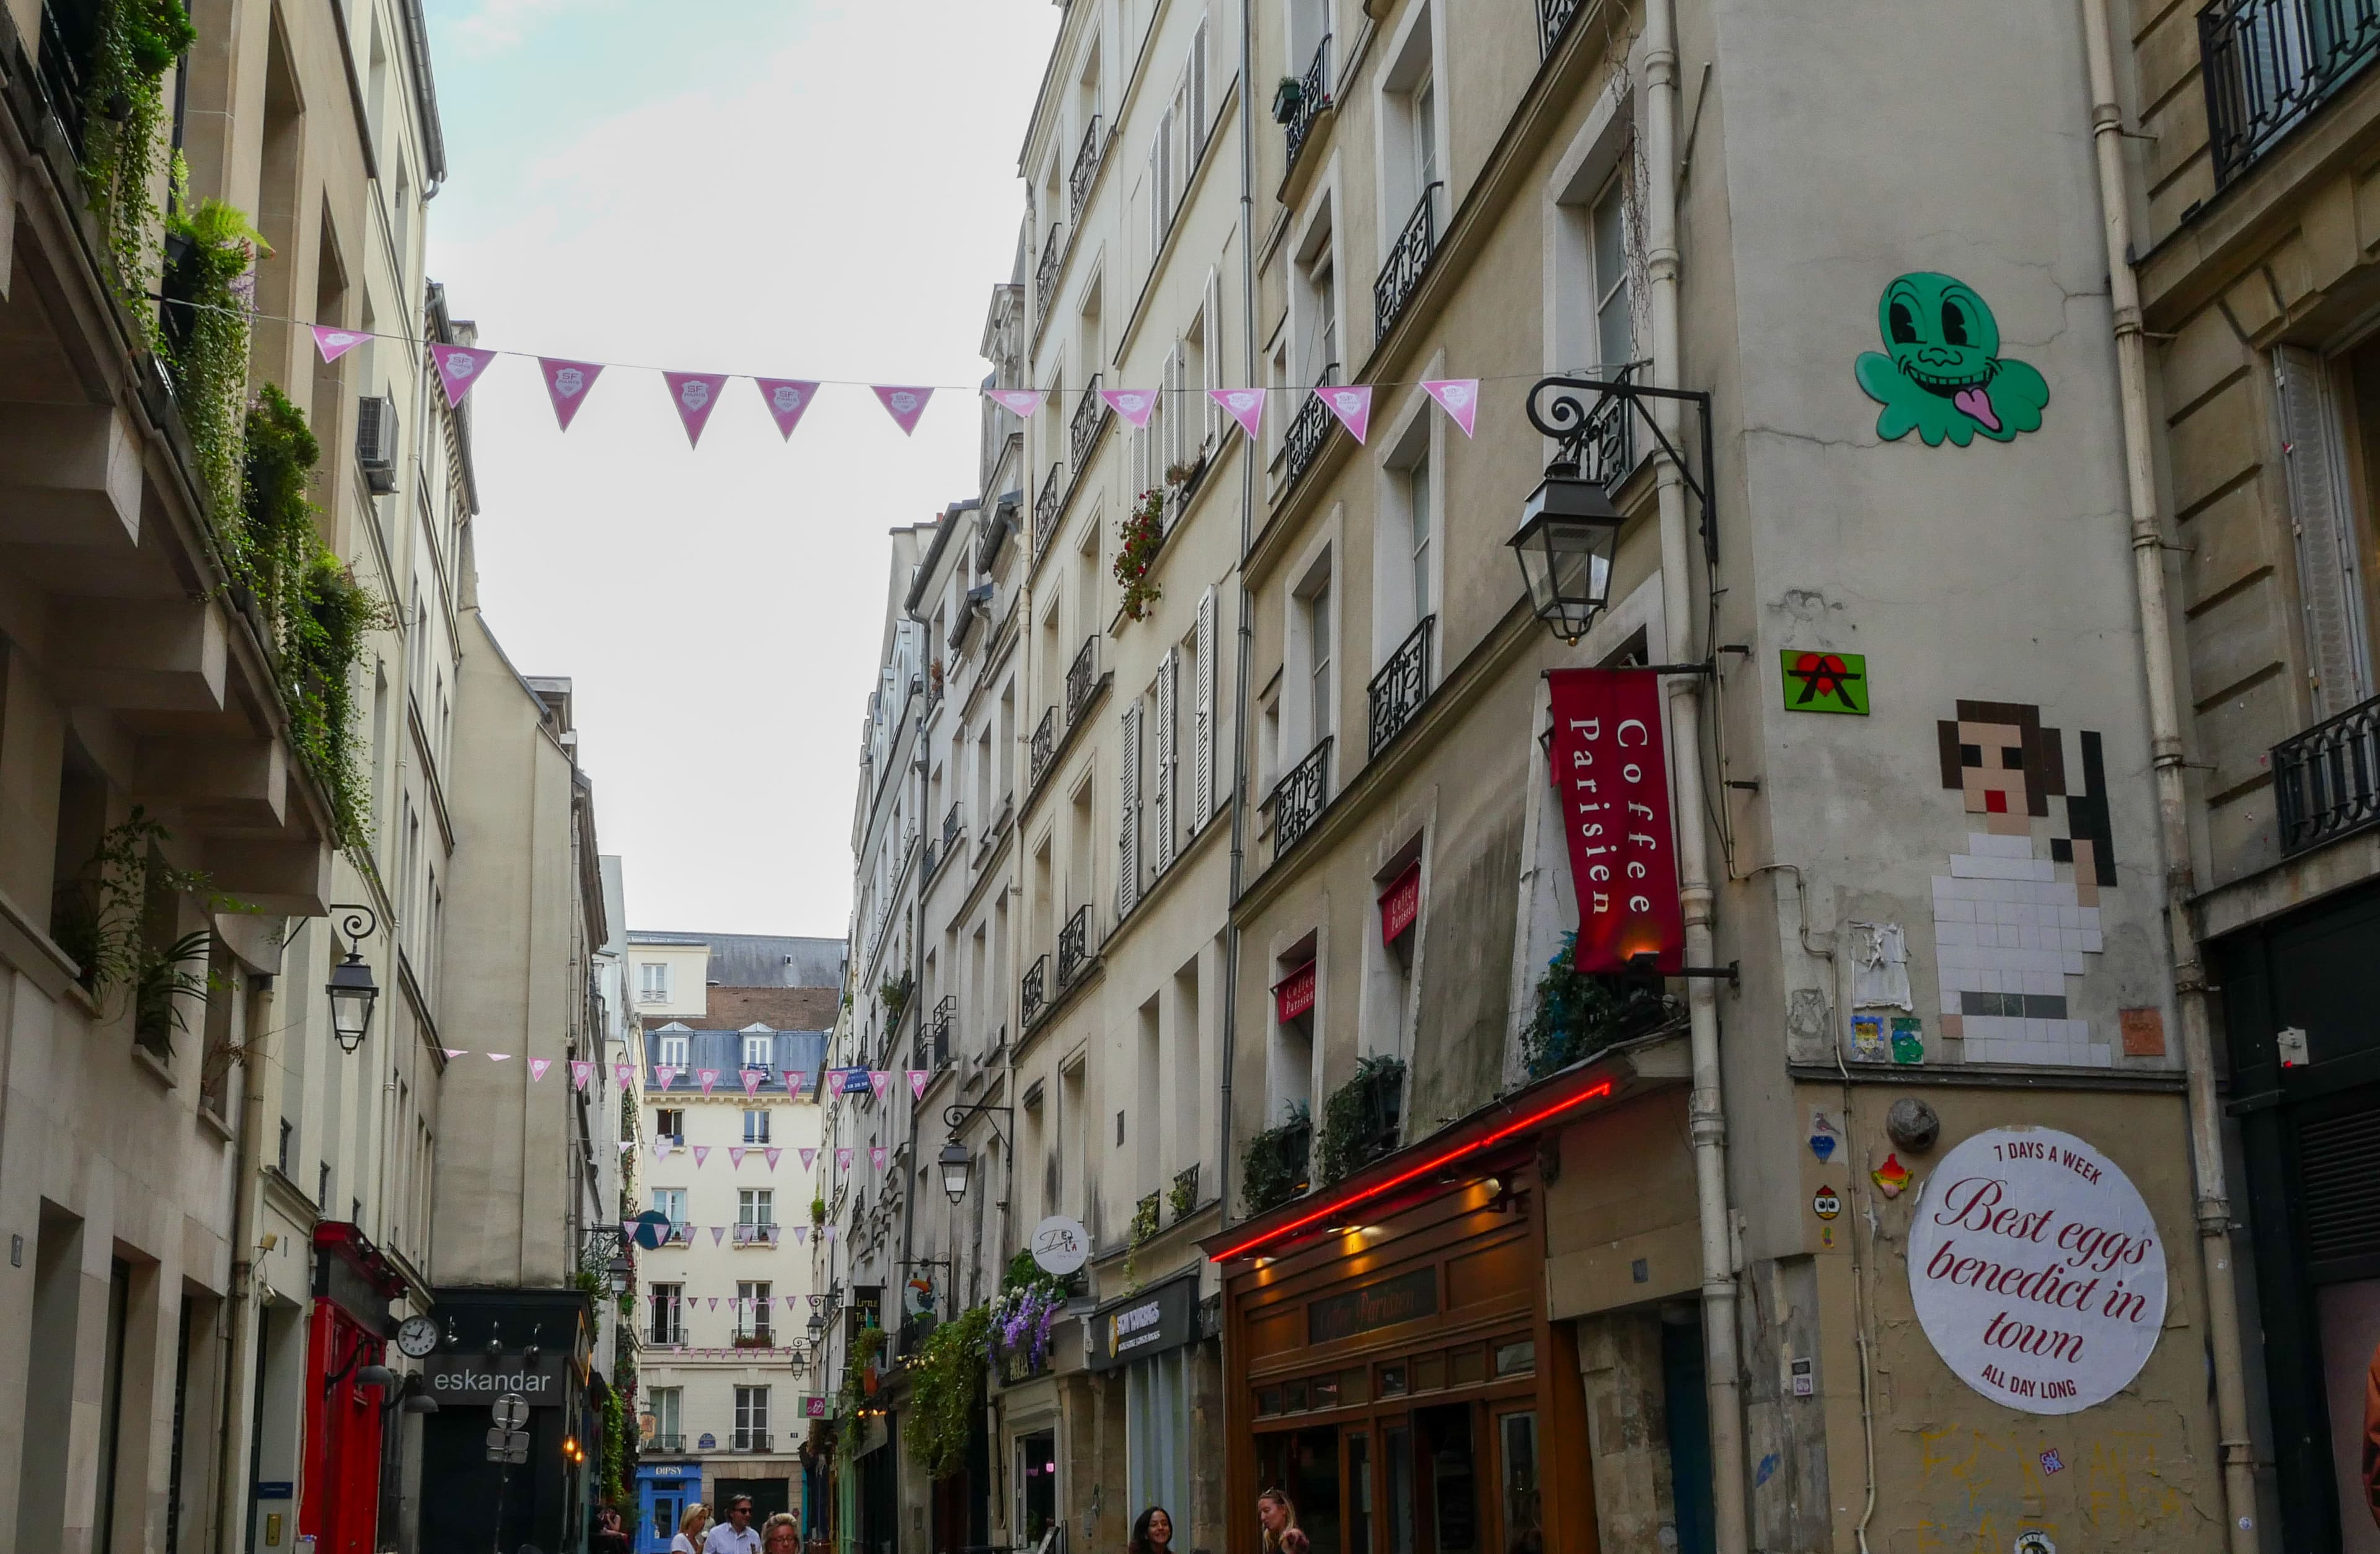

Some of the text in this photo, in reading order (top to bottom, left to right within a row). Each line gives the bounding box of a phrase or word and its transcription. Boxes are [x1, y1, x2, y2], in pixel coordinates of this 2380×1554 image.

[1569, 716, 1618, 915] Parisien
[1616, 718, 1657, 913] Coffee
[1285, 991, 1314, 1015] Parisien
[1286, 975, 1313, 1000] Coffee
[1993, 1141, 2103, 1186] 7 DAYS A WEEK
[1934, 1177, 2153, 1273] Best eggs
[1926, 1240, 2147, 1323] benedict in
[1983, 1310, 2085, 1364] town
[434, 1368, 552, 1392] eskandar
[1981, 1363, 2077, 1399] ALL DAY LONG
[655, 1466, 683, 1475] DIPSY
